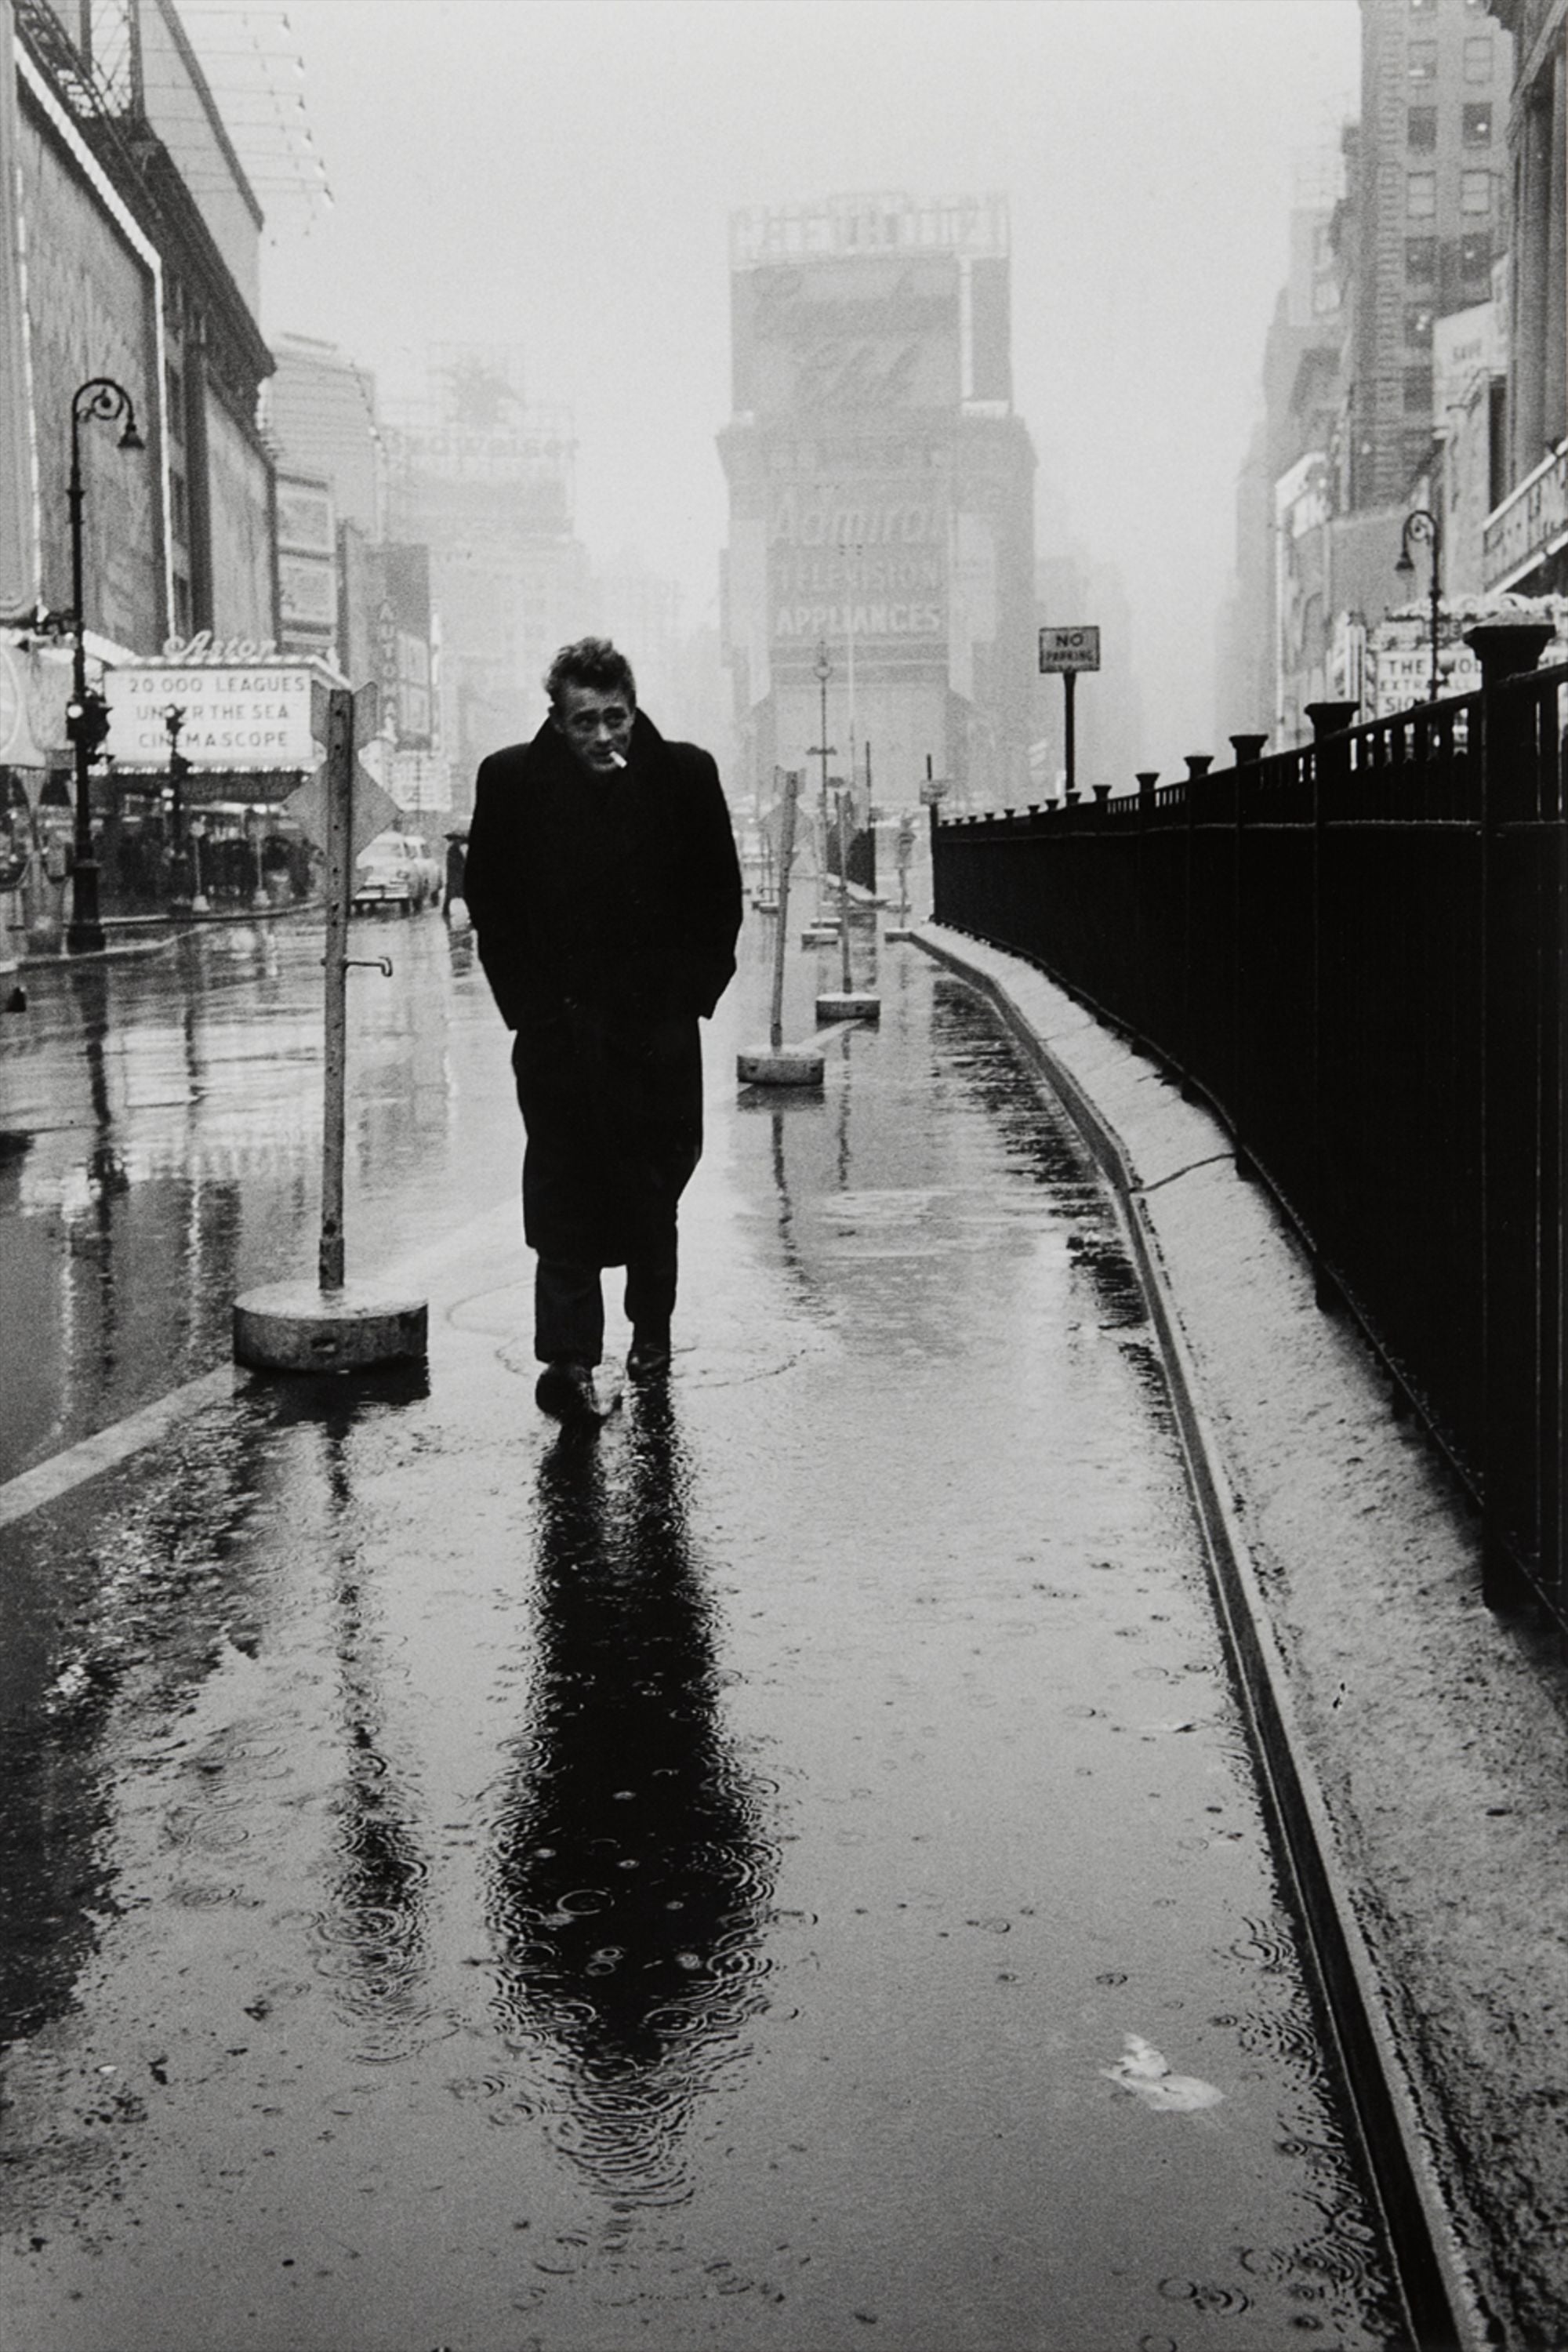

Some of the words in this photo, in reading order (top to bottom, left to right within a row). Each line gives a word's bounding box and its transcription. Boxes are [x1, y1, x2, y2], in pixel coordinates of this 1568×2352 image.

[776, 603, 941, 634] APPLIANCES
[1055, 633, 1083, 647] NO
[1388, 659, 1426, 675] THE
[216, 676, 305, 692] LEAGUES
[136, 705, 205, 720] UNR
[211, 705, 243, 720] THE
[252, 704, 289, 720] SEA
